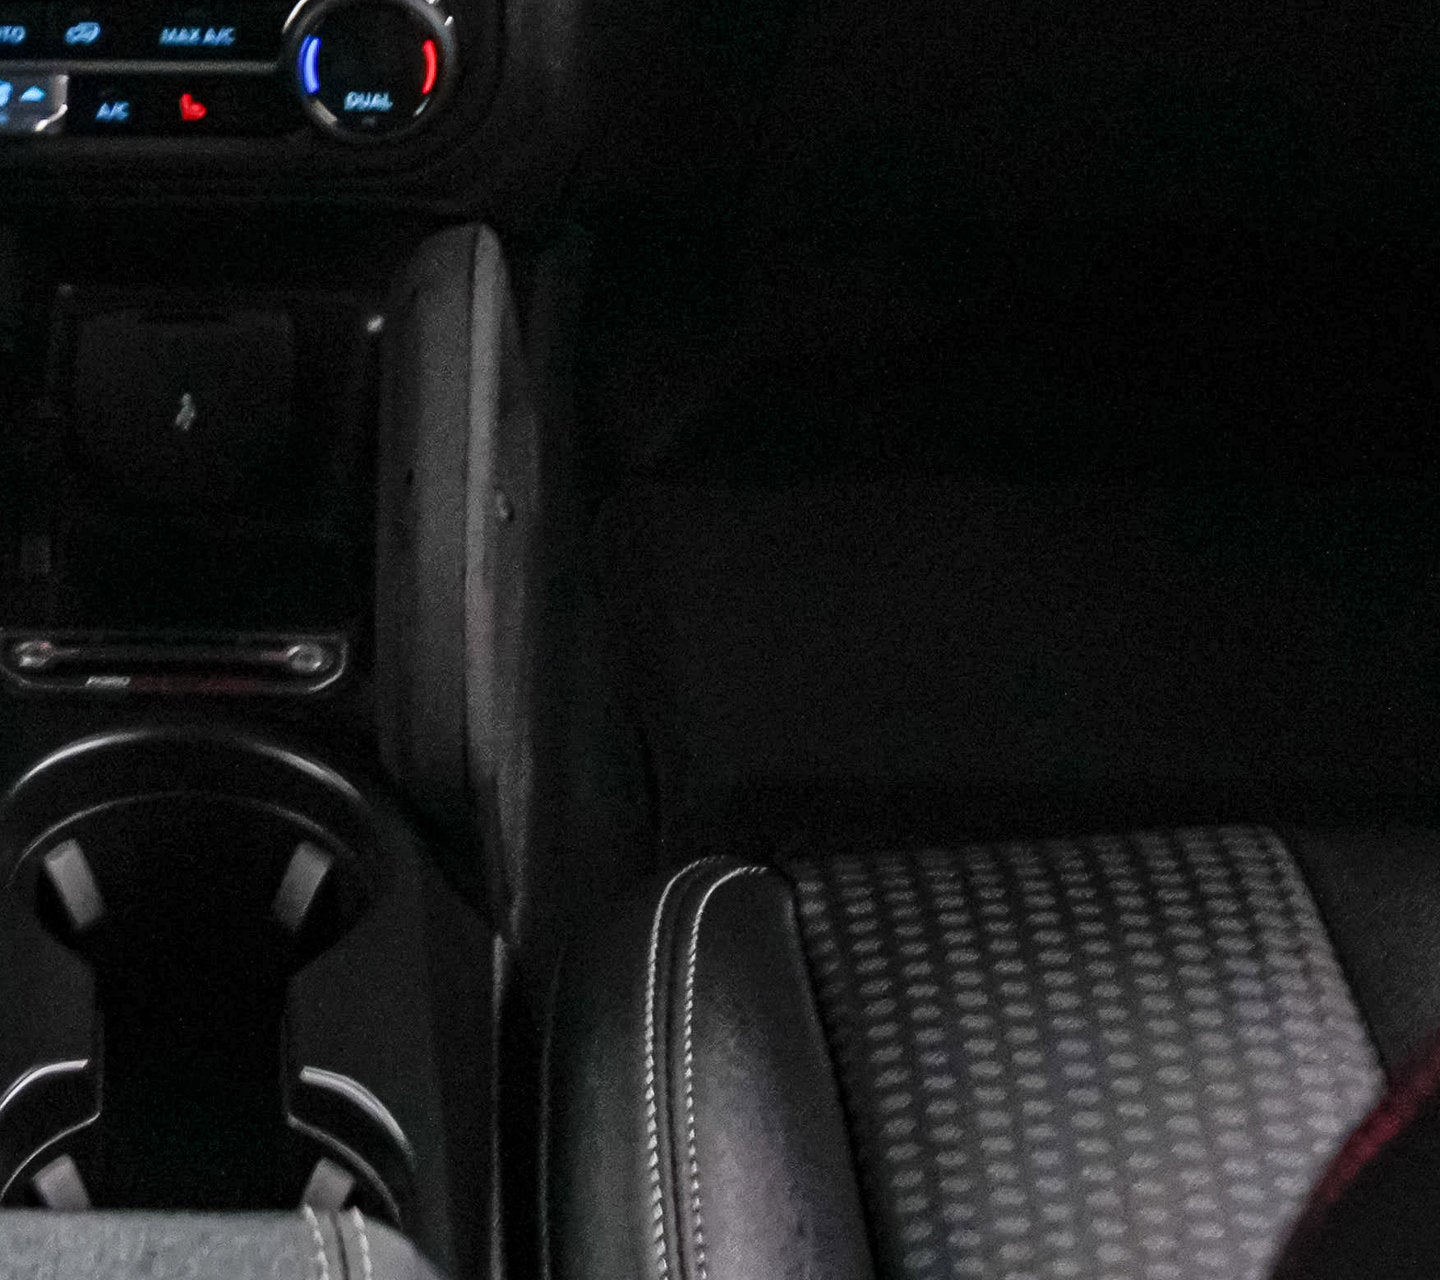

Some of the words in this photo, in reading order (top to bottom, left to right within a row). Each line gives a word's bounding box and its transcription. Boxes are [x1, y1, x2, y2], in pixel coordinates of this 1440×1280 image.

[160, 27, 201, 45] MAX
[202, 27, 235, 46] A/C
[344, 91, 393, 111] DUAL
[96, 101, 130, 122] A/C
